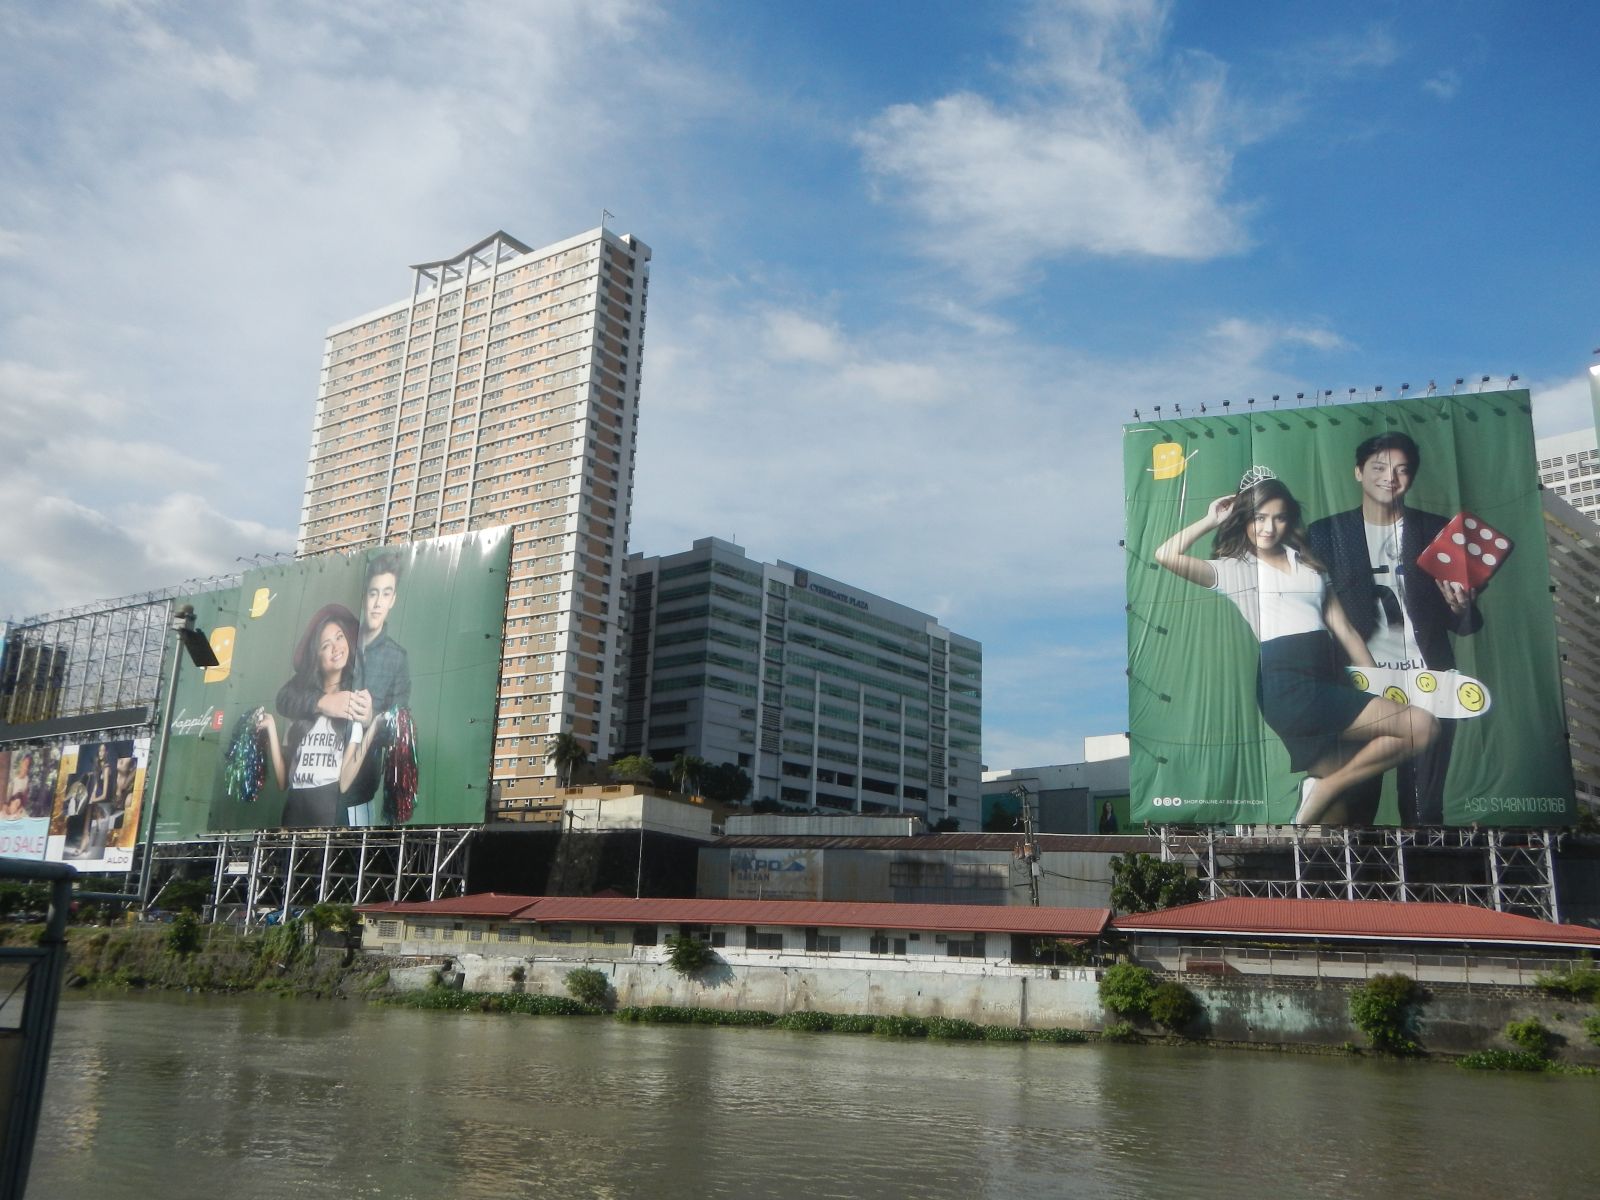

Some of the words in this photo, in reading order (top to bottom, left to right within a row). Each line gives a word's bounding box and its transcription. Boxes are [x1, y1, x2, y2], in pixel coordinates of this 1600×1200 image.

[810, 583, 848, 603] CYBERGATE
[849, 596, 869, 611] PLAZA
[1464, 797, 1488, 812] ASC
[12, 835, 45, 853] SALE
[106, 856, 129, 864] ALDO
